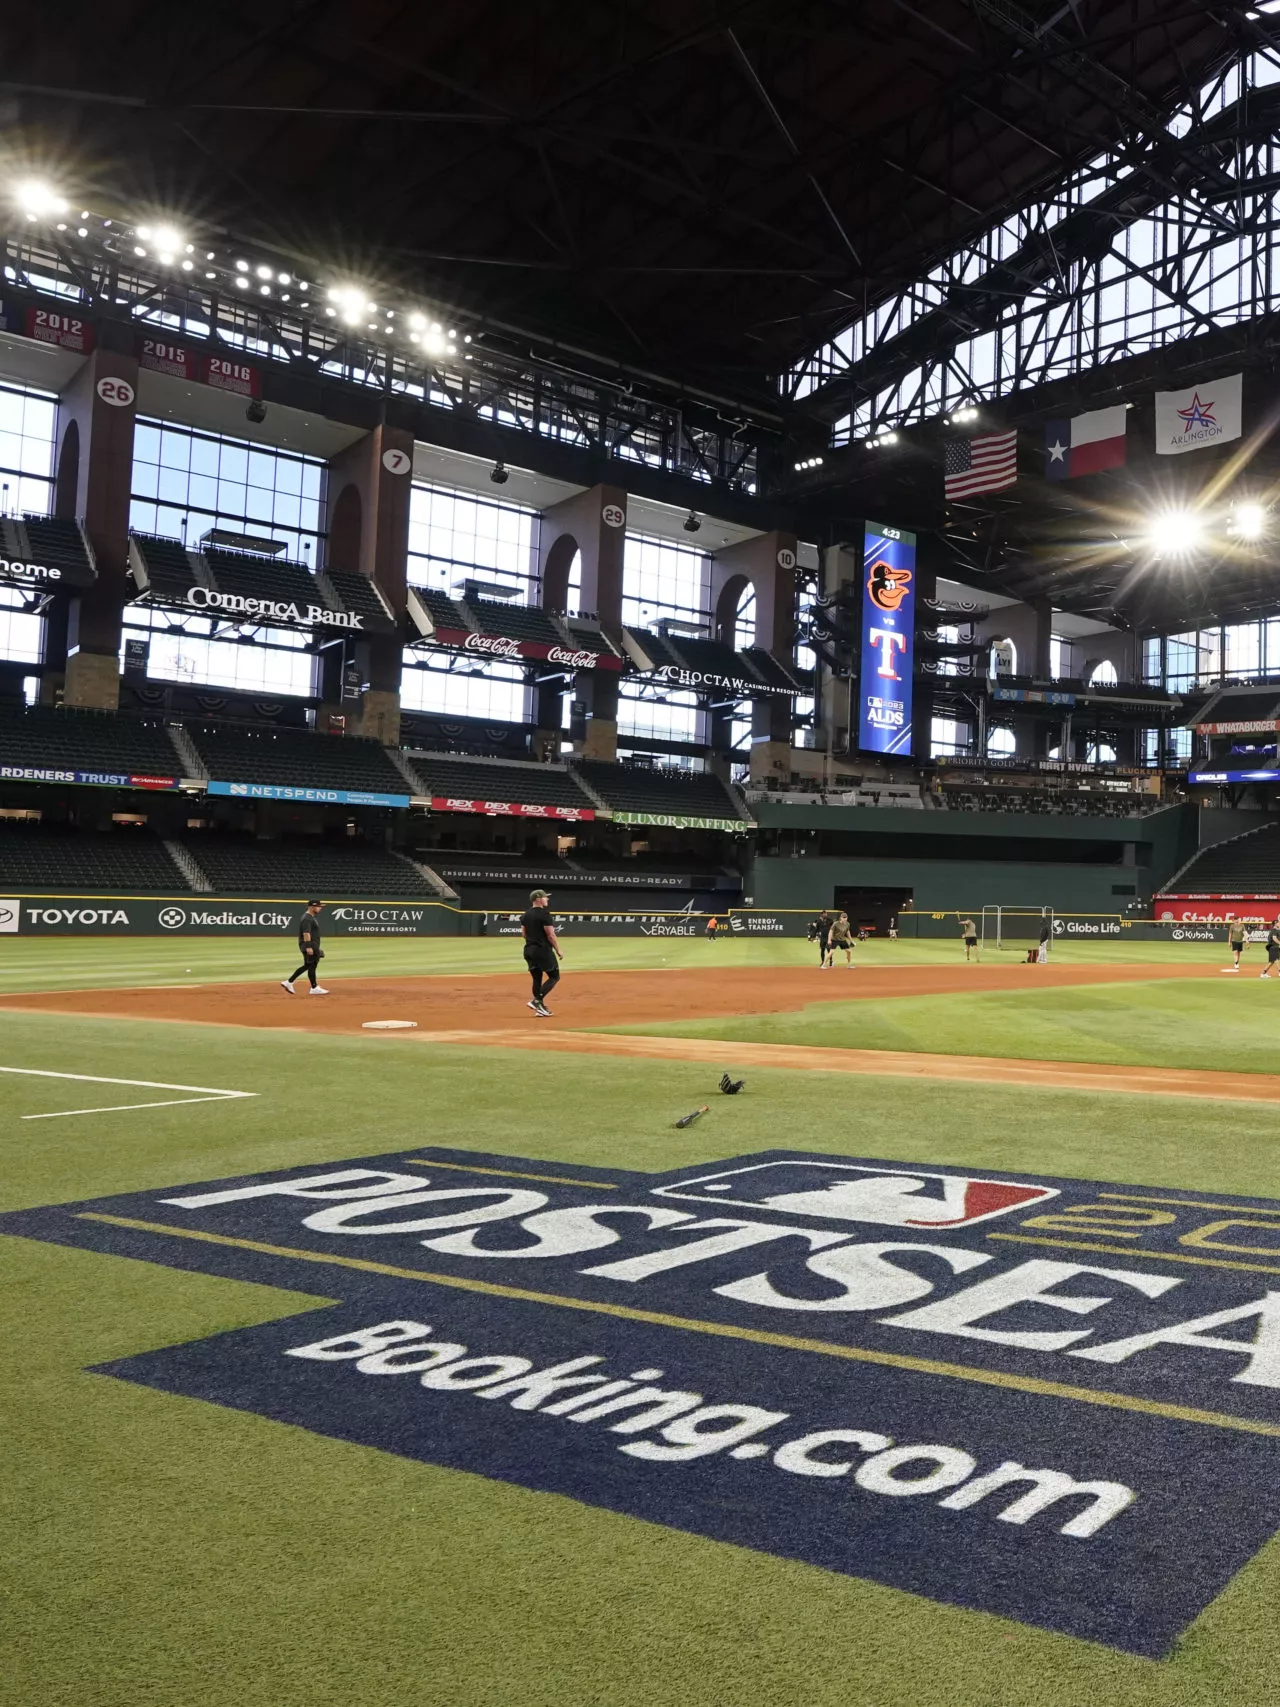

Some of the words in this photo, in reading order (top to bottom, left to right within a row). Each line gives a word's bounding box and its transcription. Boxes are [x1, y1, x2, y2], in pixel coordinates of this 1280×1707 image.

[35, 310, 83, 335] 2012
[143, 339, 186, 363] 2015
[209, 358, 251, 381] 2016
[101, 381, 130, 402] 26
[1171, 426, 1223, 445] ARLINGTON
[391, 455, 403, 470] 7
[605, 510, 623, 523] 29
[882, 528, 901, 539] 4:23
[781, 553, 792, 565] 10
[306, 605, 364, 630] Bank
[464, 633, 521, 655] Coca-Cola
[547, 646, 599, 668] Coca-Cola
[668, 665, 744, 690] CHOCTAW
[744, 682, 770, 692] CASINOS
[777, 687, 802, 696] RESORTS
[868, 707, 904, 725] ALDS
[1216, 720, 1276, 733] WHATABURGER
[947, 757, 987, 767] PRIORITY
[990, 759, 1015, 768] GOLD
[1039, 761, 1065, 771] HART
[1068, 763, 1095, 772] HVAC
[1, 767, 75, 782] RDENERS
[80, 773, 127, 785] TRUST
[1116, 767, 1163, 775] PLUCKERS
[251, 786, 338, 800] NETSPEND
[446, 799, 474, 808] DEX
[484, 801, 511, 811] DEX
[520, 804, 546, 813] DEX
[556, 807, 580, 816] DEX
[627, 812, 677, 828] LUXOR
[680, 816, 745, 832] STAFFING
[601, 876, 683, 885] AHEAD-READY
[26, 909, 130, 925] TOYOTA
[190, 911, 257, 926] Medical
[258, 911, 292, 929] City
[338, 908, 424, 921] CHOCTAW
[1067, 921, 1099, 933] Globe
[1101, 922, 1120, 933] Life
[1185, 930, 1214, 939] Kubota
[285, 1321, 1137, 1538] Booking.com
